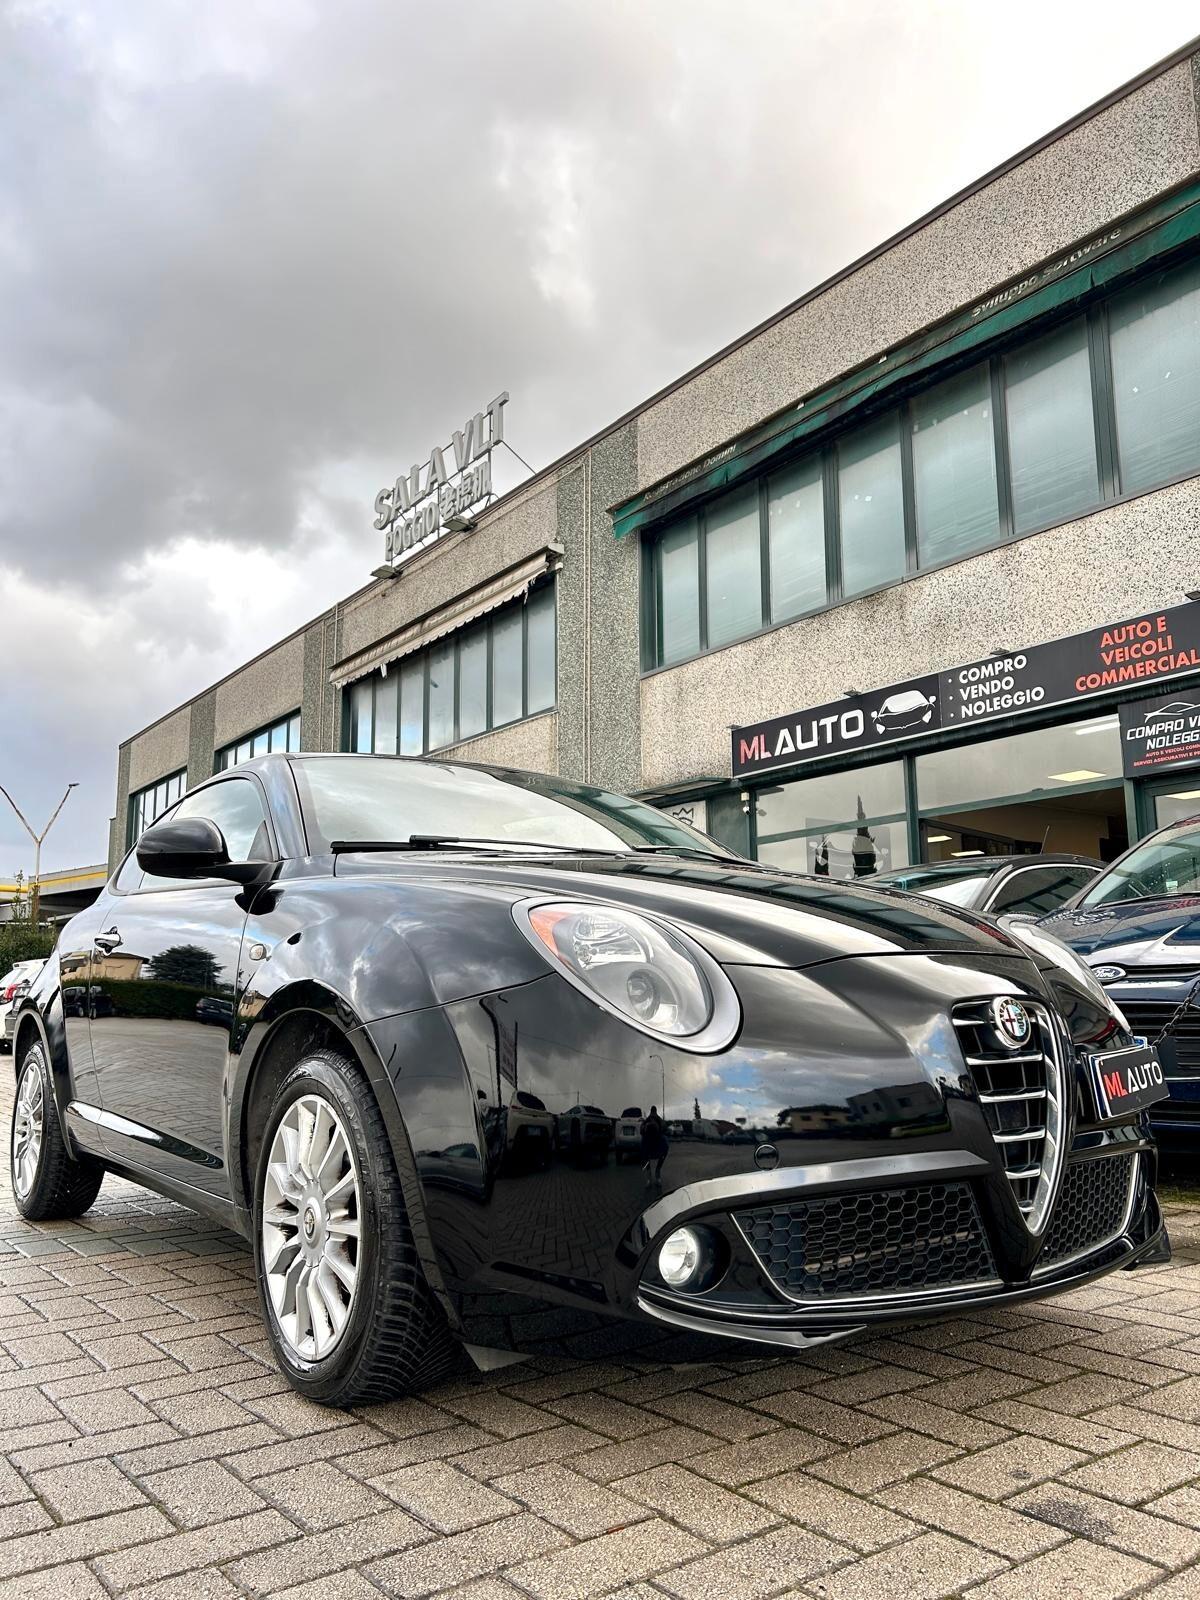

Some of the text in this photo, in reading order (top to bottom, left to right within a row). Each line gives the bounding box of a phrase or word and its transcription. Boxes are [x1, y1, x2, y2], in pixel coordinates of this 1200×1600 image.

[373, 391, 509, 531] SALA VLT
[385, 502, 440, 562] POGGIO
[1100, 616, 1167, 649] AUTO E
[1100, 635, 1173, 666] VEICOLI
[959, 654, 1027, 683] COMPRO
[960, 676, 1015, 701] VENDO
[961, 686, 1045, 719] NOLEGGIO
[1126, 718, 1185, 741] COMPRO
[1146, 730, 1200, 751] NOLEGG
[1165, 746, 1185, 754] VEICOLI
